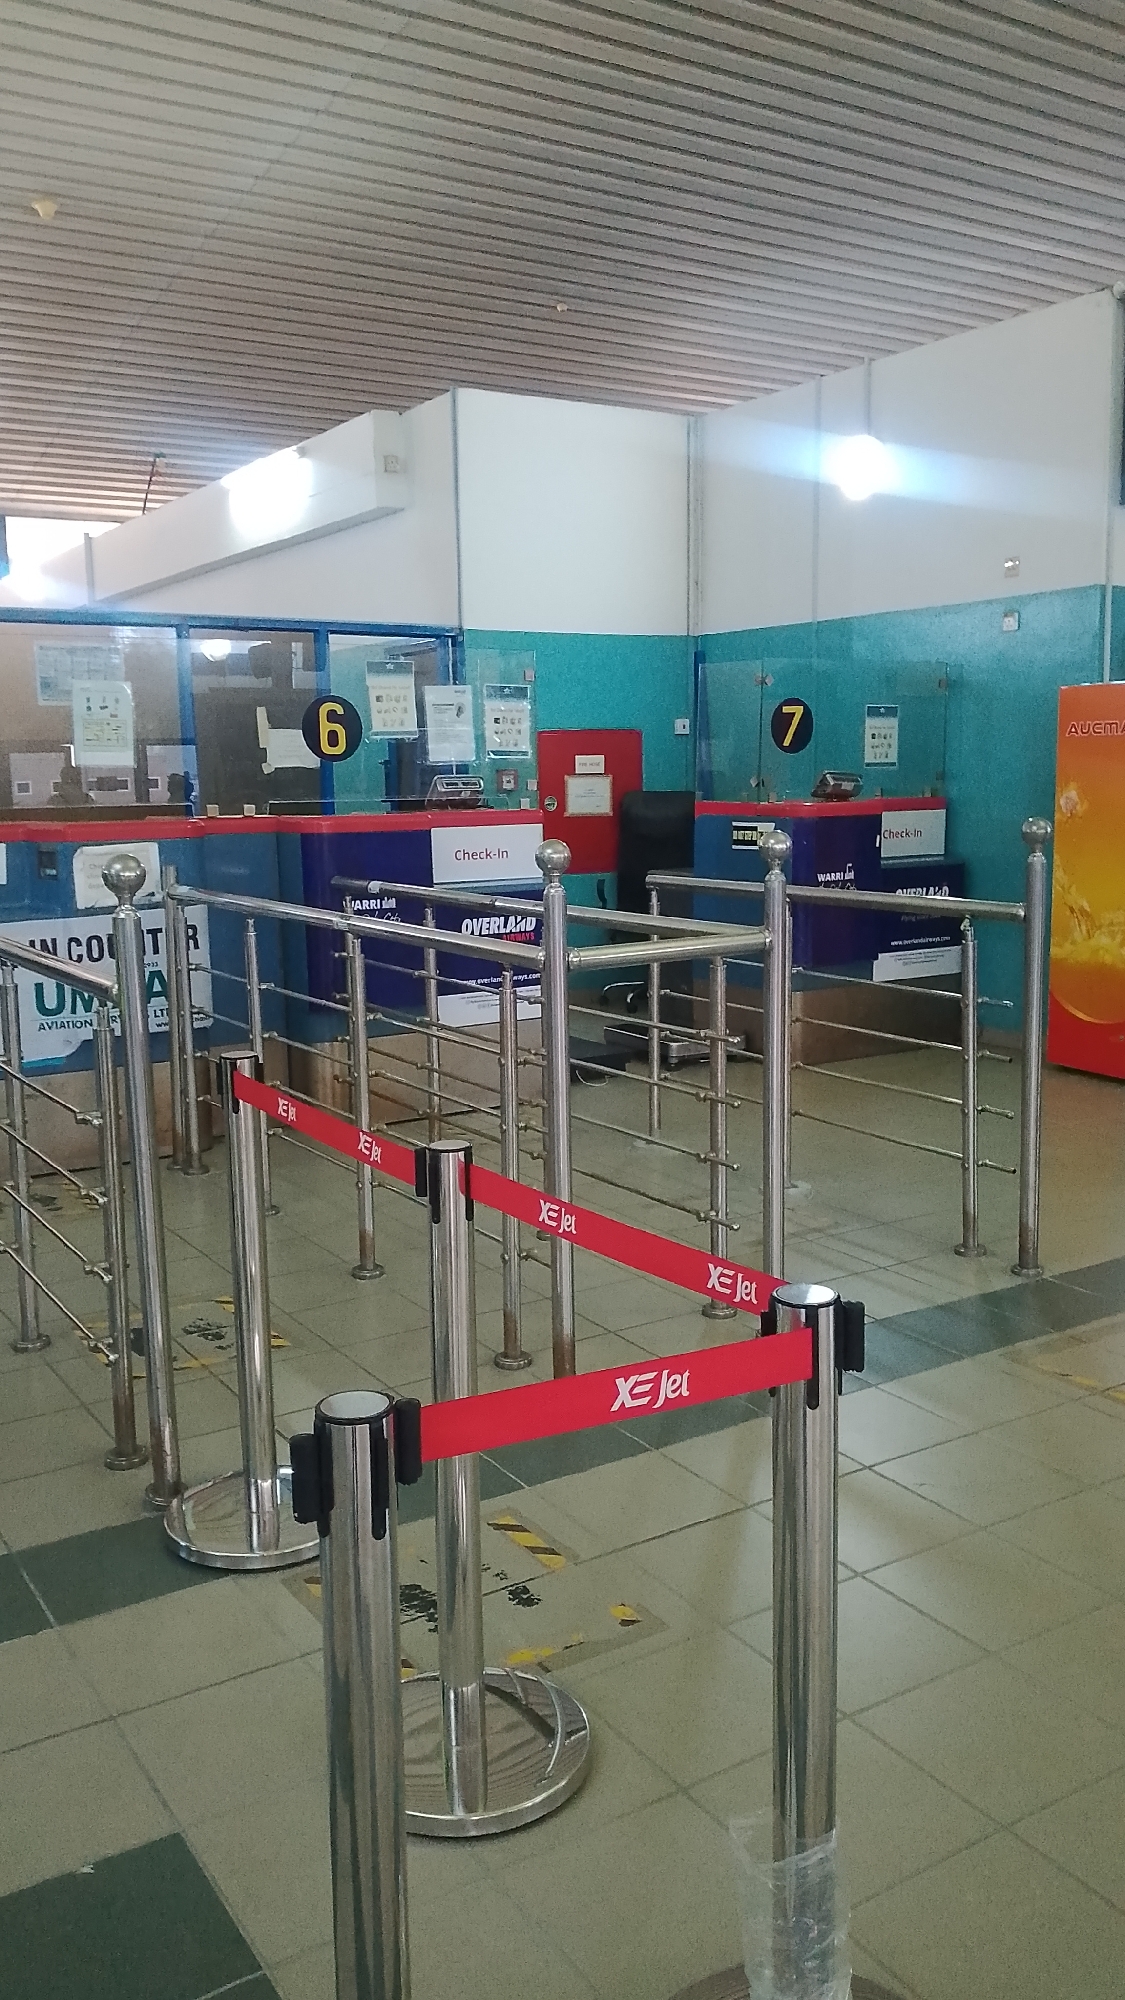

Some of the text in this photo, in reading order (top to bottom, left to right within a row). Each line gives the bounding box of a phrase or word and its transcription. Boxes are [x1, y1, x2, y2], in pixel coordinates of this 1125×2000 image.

[318, 702, 347, 755] 6
[782, 705, 804, 747] 7
[883, 828, 922, 840] Check-In
[454, 848, 509, 861] Check-In
[817, 872, 843, 882] WARRI
[462, 915, 537, 935] OVERLAND
[38, 1019, 93, 1032] AVIATION
